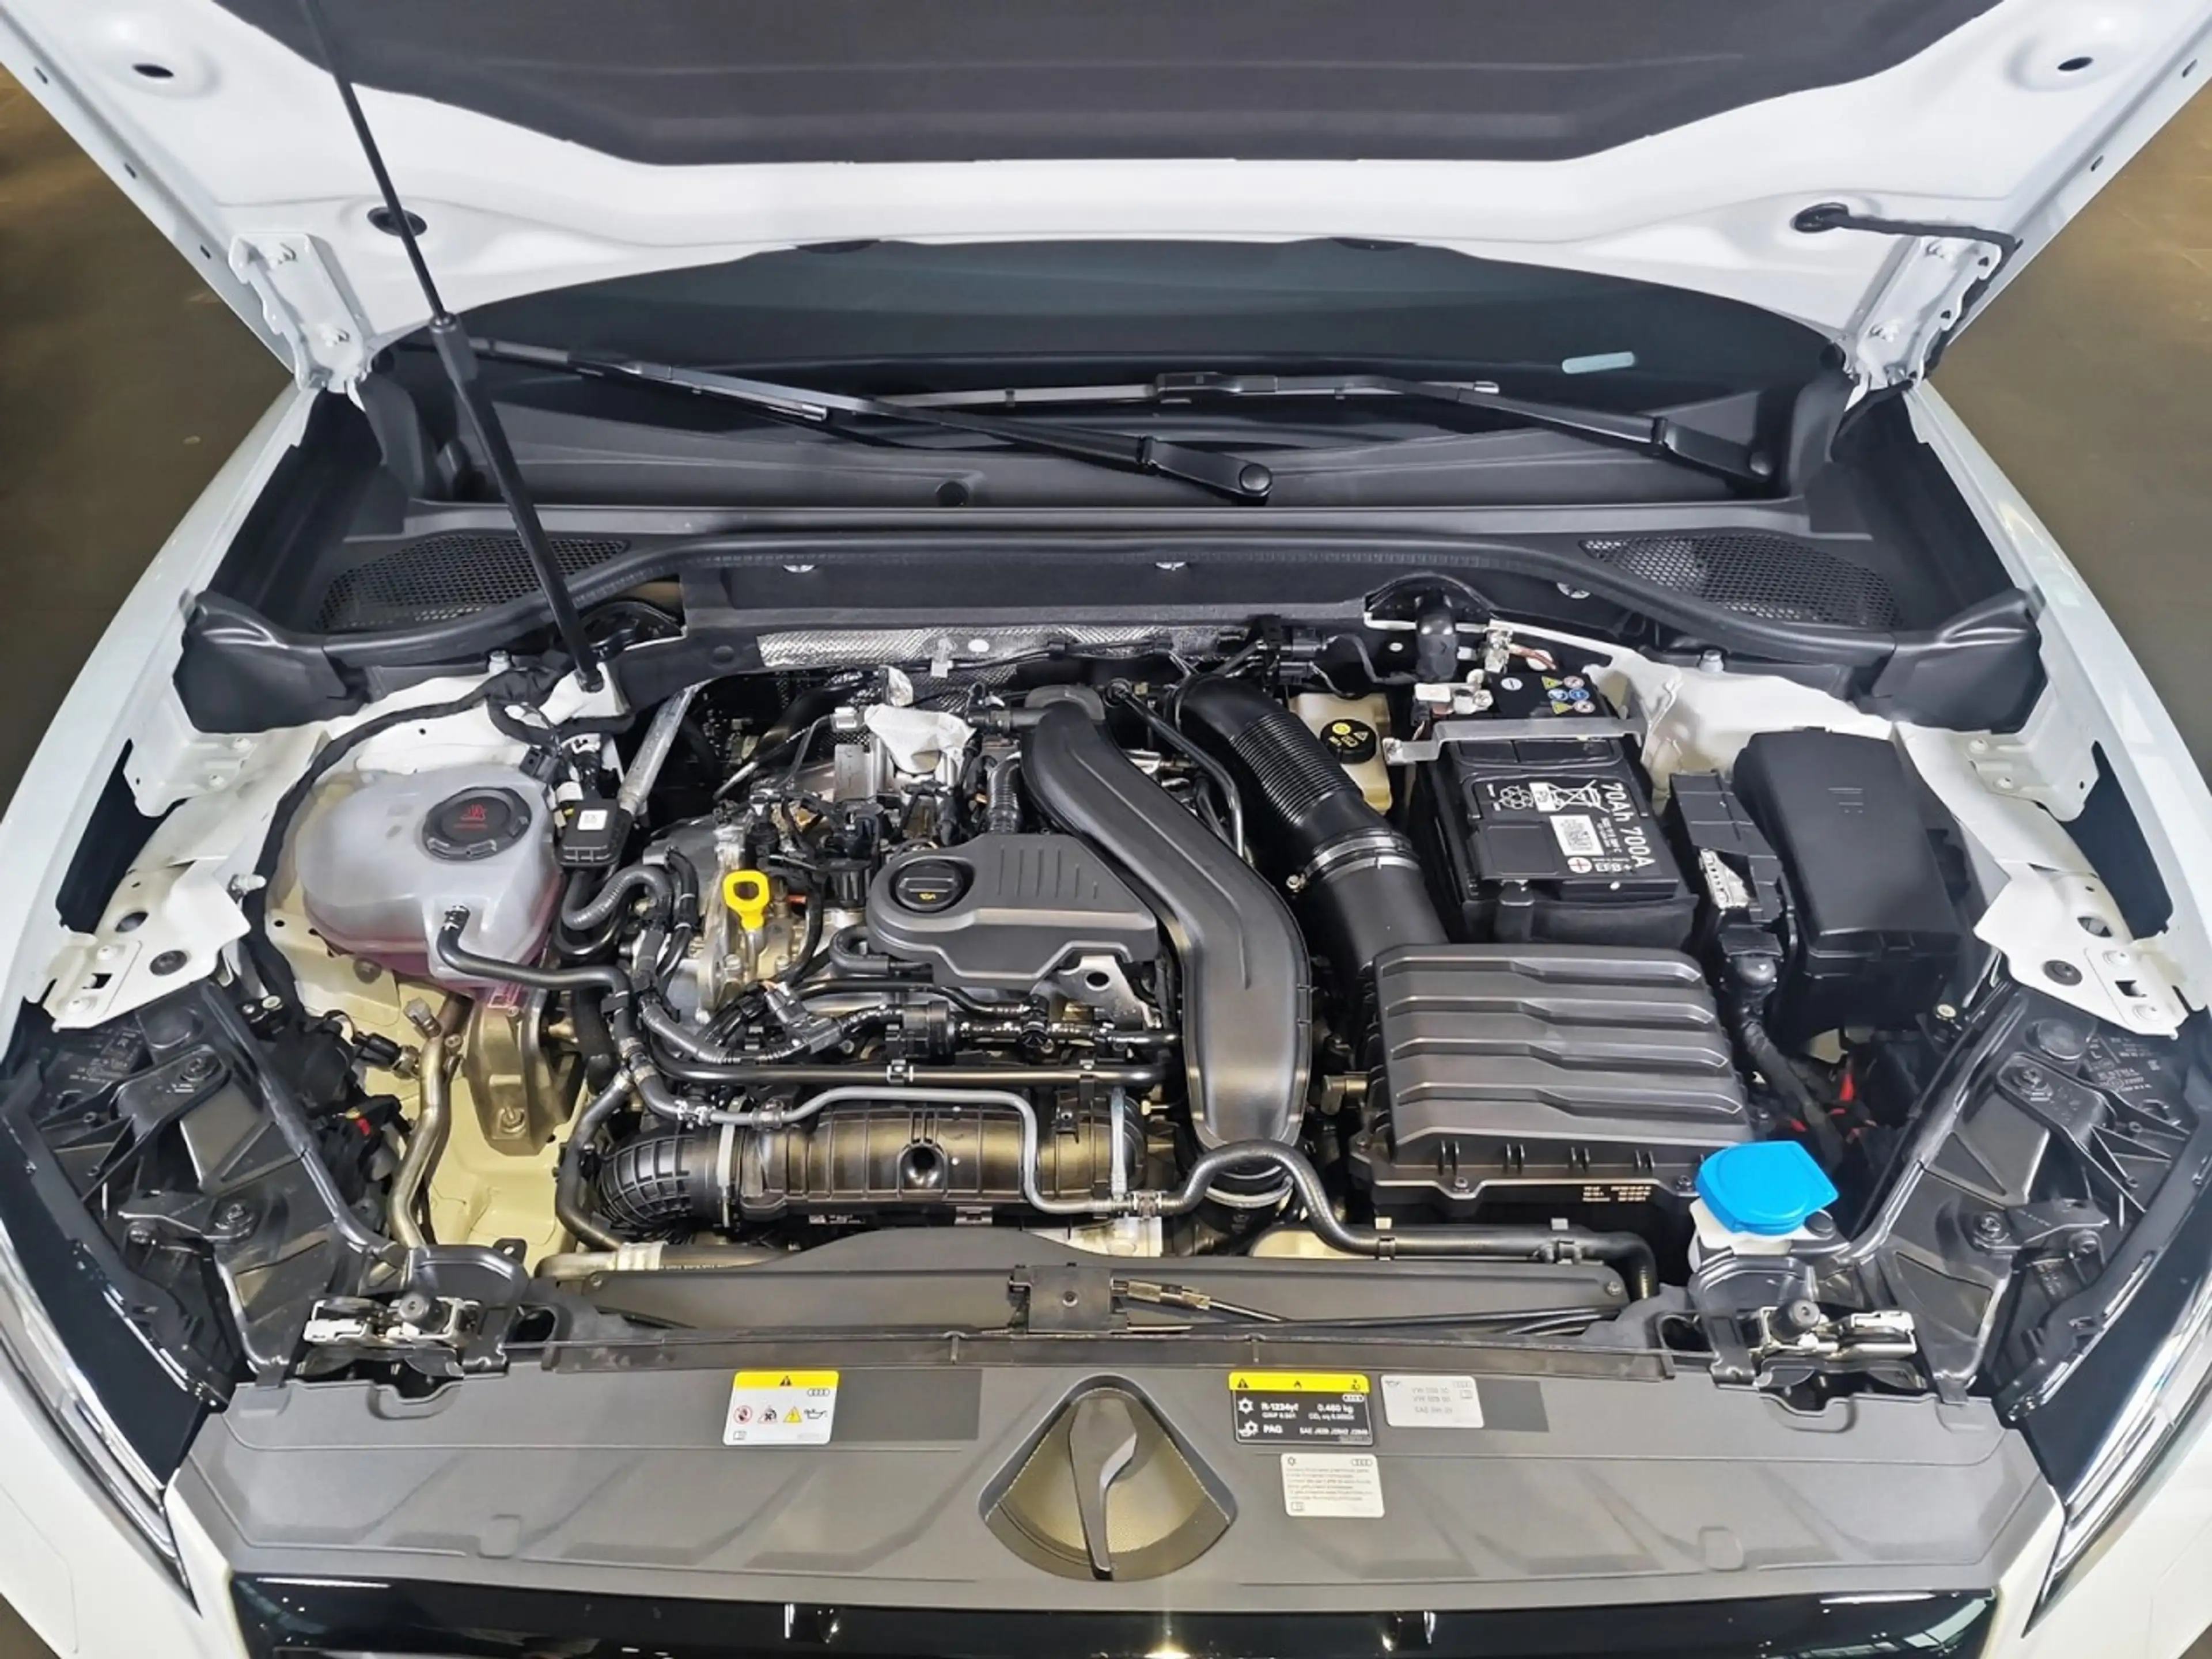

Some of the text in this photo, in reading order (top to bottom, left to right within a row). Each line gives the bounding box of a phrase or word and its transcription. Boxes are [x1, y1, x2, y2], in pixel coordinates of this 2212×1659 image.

[1600, 782, 1634, 822] 70Ah
[1619, 826, 1656, 869] 700A
[1263, 1424, 1283, 1434] PAG
